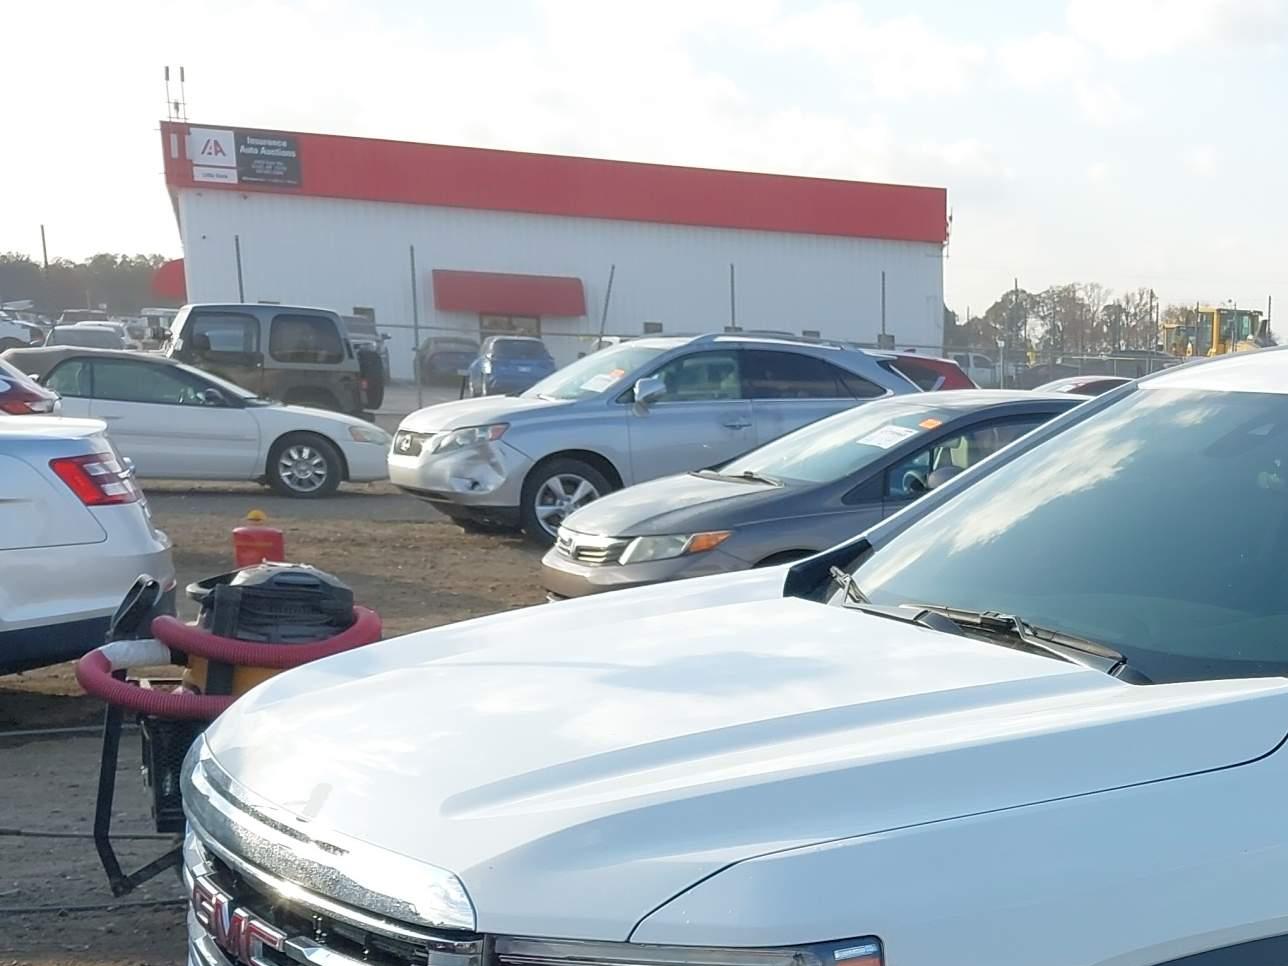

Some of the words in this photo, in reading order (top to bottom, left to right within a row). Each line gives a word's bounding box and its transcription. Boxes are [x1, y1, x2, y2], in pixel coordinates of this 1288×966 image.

[247, 136, 288, 147] Insurance
[240, 145, 258, 155] Auto
[260, 147, 297, 158] Auctions
